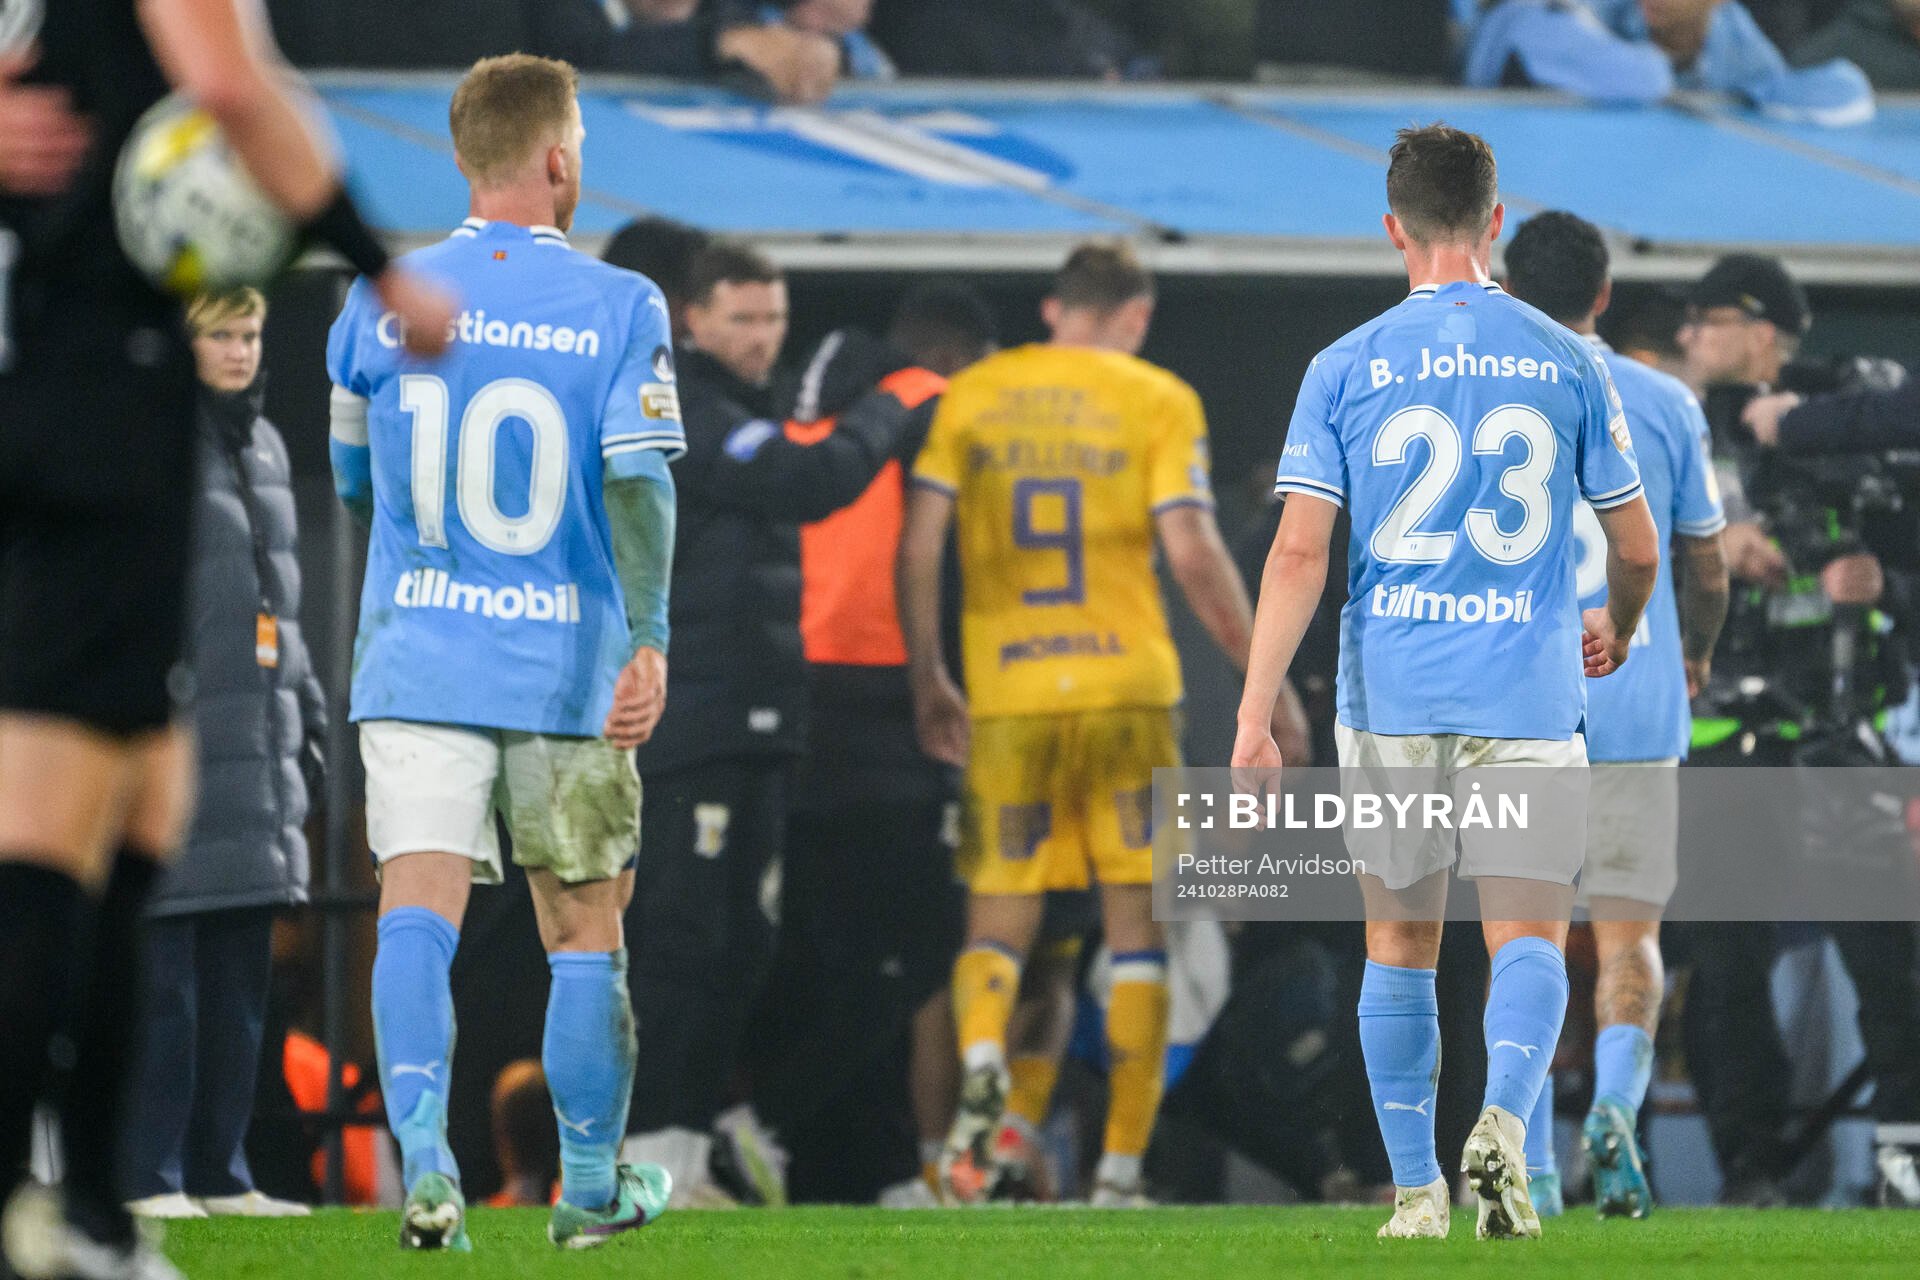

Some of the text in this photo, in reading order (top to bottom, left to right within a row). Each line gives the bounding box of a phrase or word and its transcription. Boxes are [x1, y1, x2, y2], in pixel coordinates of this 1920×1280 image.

[1369, 344, 1559, 389] B. Johnsen
[400, 374, 569, 556] 10
[1370, 403, 1558, 566] 23
[1012, 477, 1087, 606] 9
[394, 567, 581, 624] tillmobil
[1372, 584, 1533, 624] tillmobil
